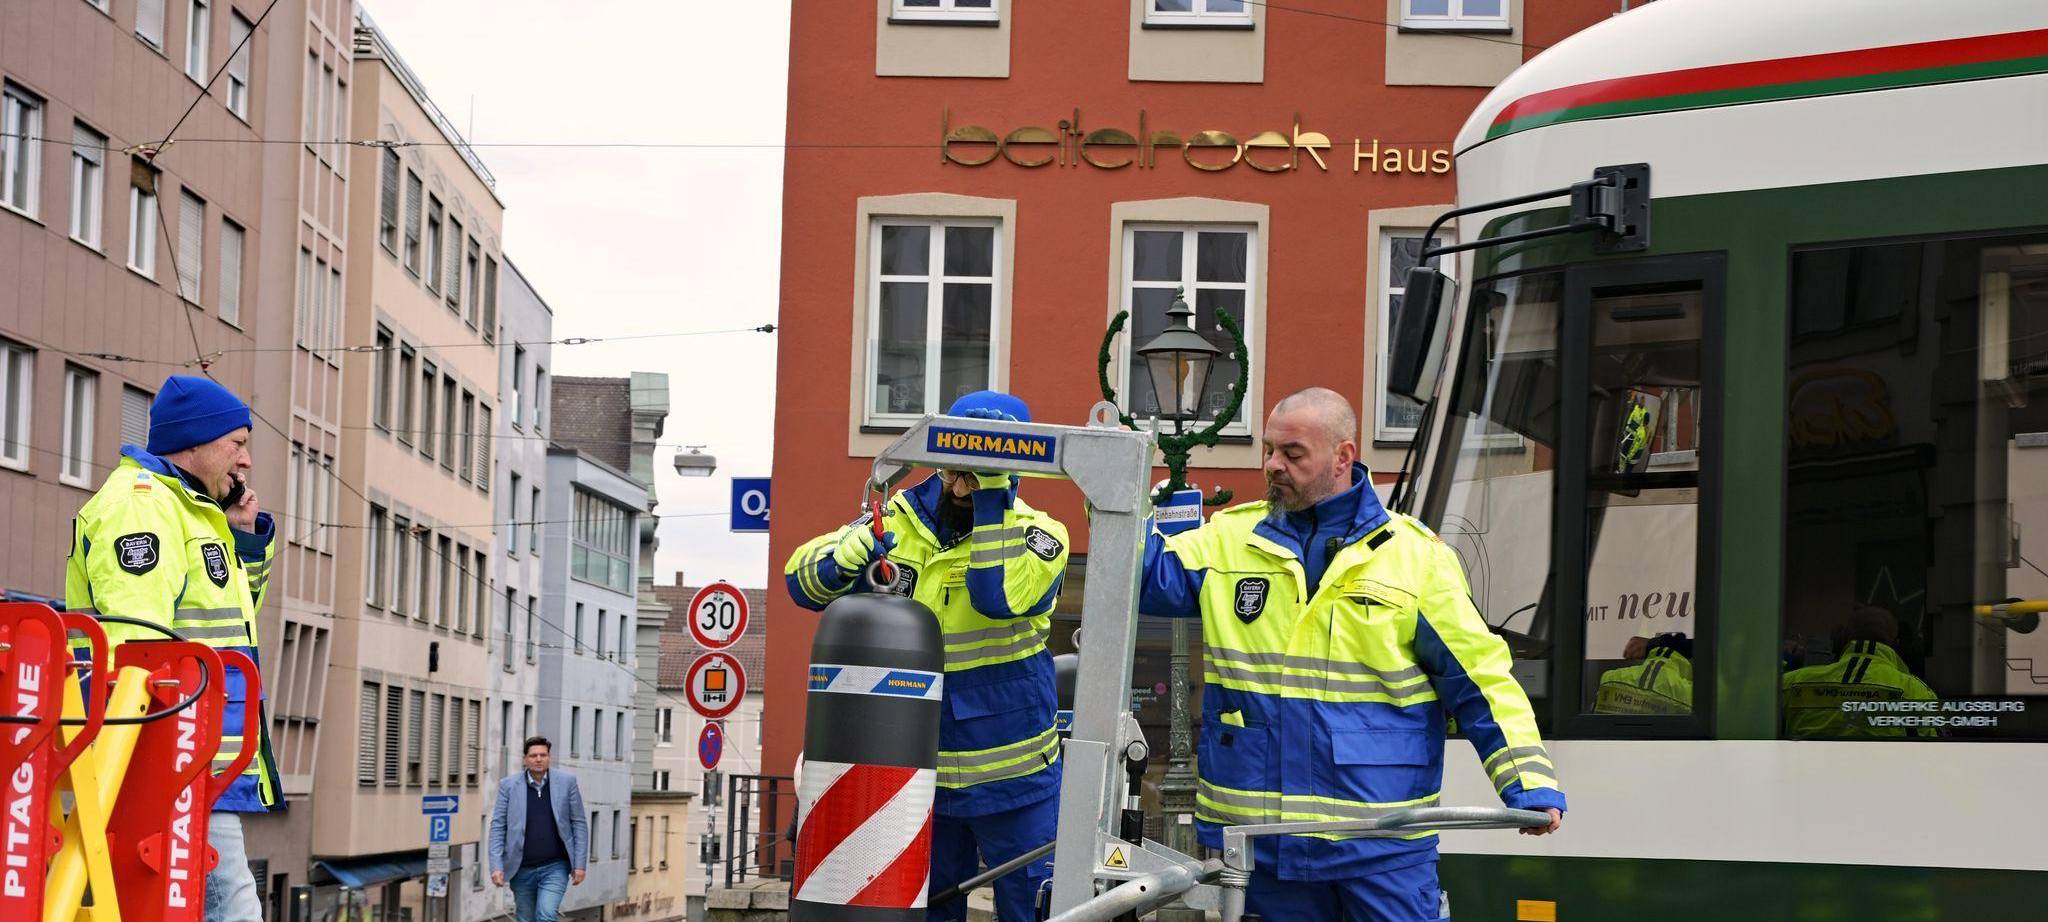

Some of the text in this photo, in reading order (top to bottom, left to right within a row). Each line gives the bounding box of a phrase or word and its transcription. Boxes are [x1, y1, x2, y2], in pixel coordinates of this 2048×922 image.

[942, 104, 1451, 173] beitelrock Haus
[936, 432, 1046, 457] HÖRMANN
[1156, 509, 1198, 520] Einbahnstraße
[701, 600, 735, 630] 30
[1841, 702, 2025, 712] STADTWERKE AUGSBURG
[1867, 716, 1998, 727] VERKEHRS-GMBH
[433, 818, 446, 839] P
